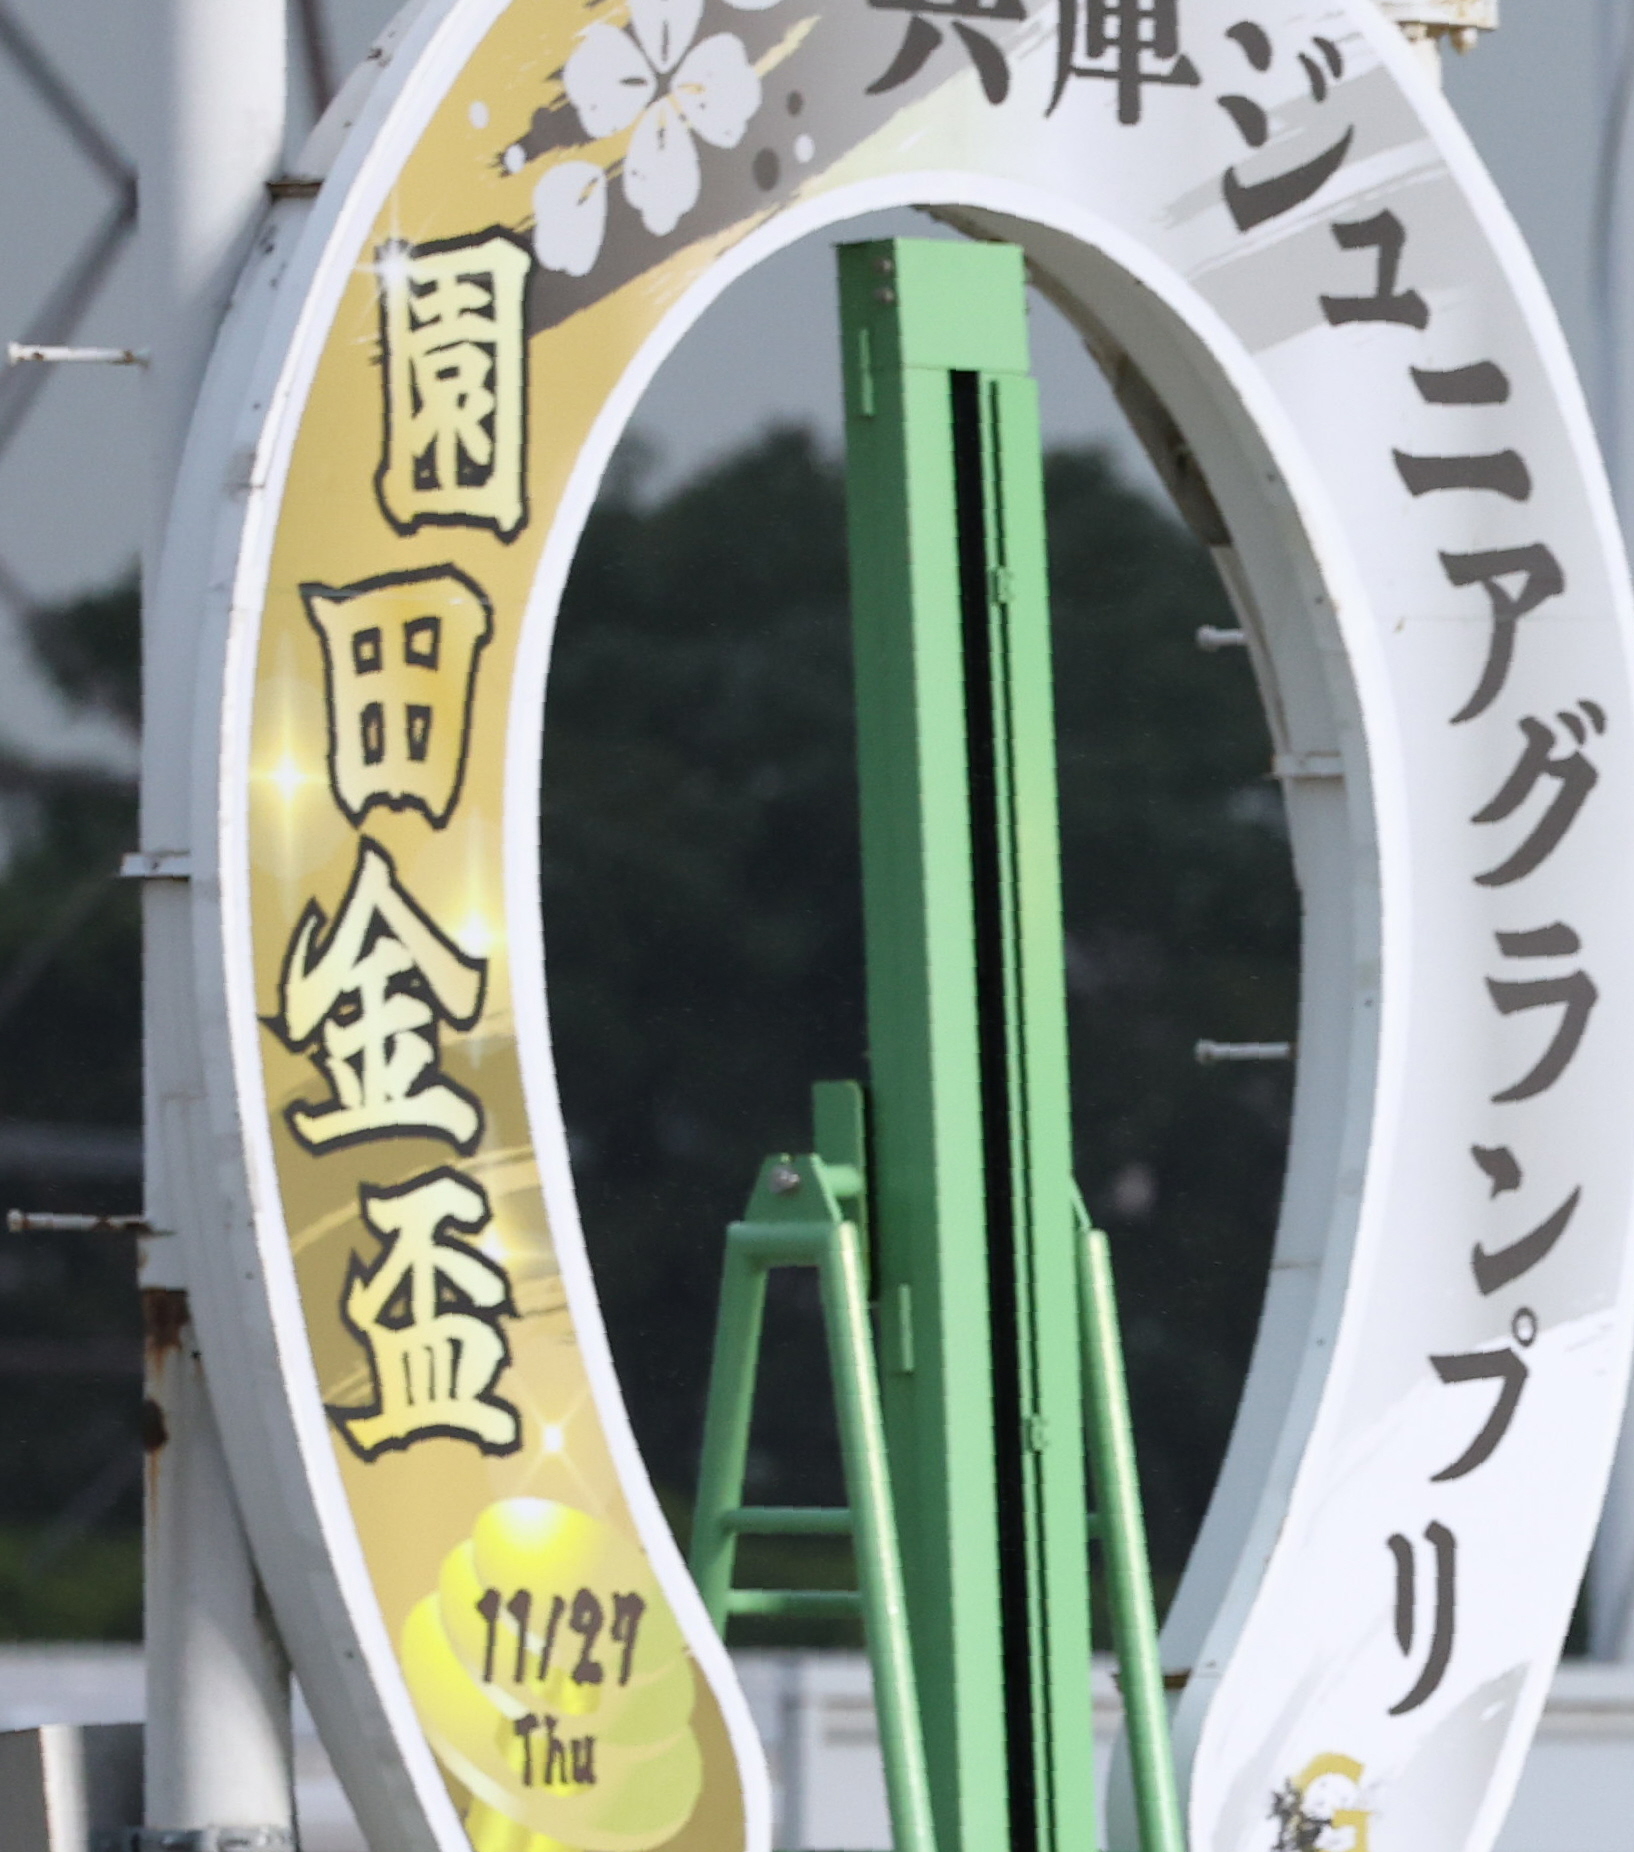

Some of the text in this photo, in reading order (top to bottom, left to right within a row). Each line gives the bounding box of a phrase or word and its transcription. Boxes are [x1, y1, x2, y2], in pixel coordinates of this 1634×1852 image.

[259, 224, 531, 1462] 園田金盃
[475, 1588, 646, 1687] 11/27
[513, 1713, 597, 1786] Thu
